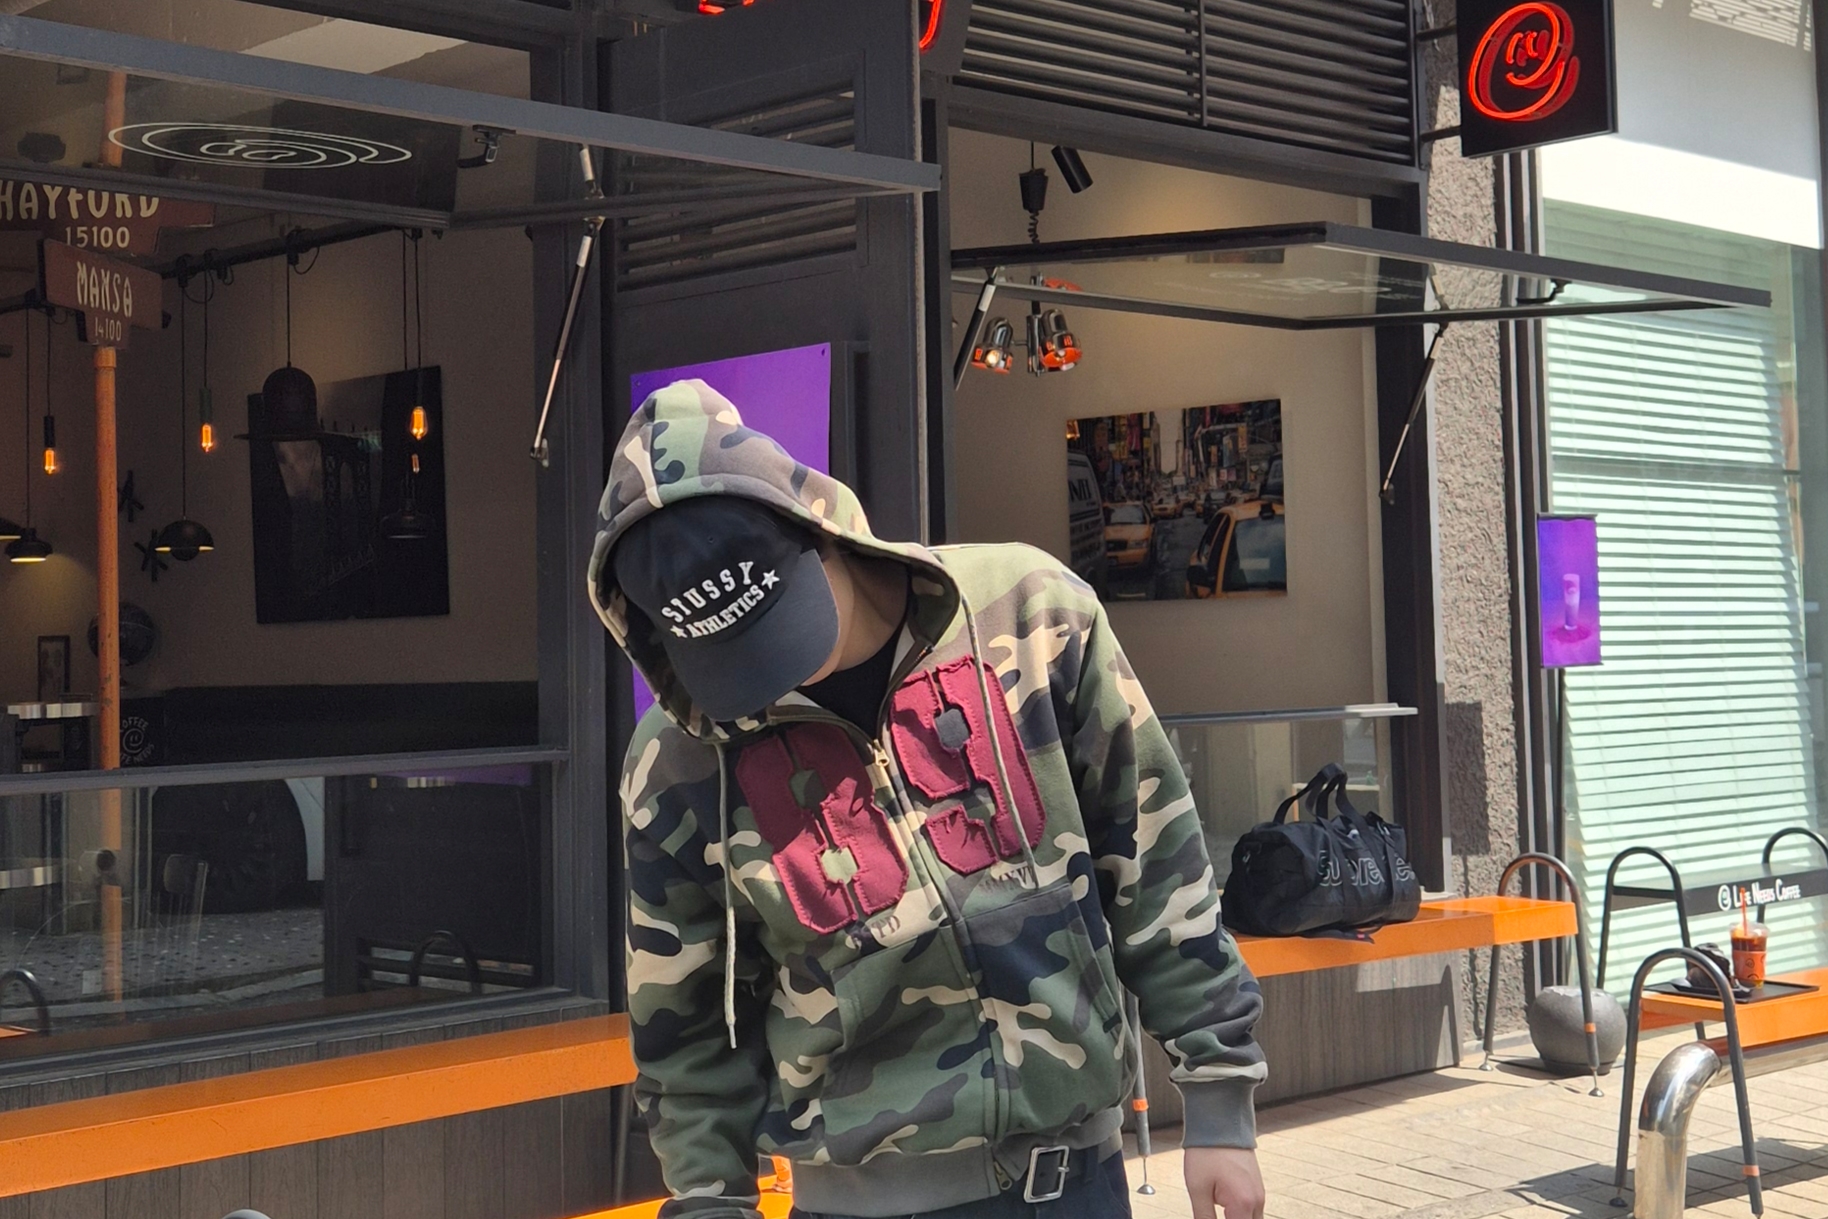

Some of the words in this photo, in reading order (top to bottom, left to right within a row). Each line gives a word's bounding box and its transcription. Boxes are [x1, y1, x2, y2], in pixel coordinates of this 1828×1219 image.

[0, 179, 160, 221] HAYFORD
[65, 226, 130, 249] 15100
[76, 261, 133, 318] MANSA
[94, 317, 122, 342] 14100
[661, 561, 754, 623] STUSSY
[685, 584, 765, 638] ATHLETICS
[120, 716, 149, 733] OFFEE
[1732, 884, 1753, 908] LIE
